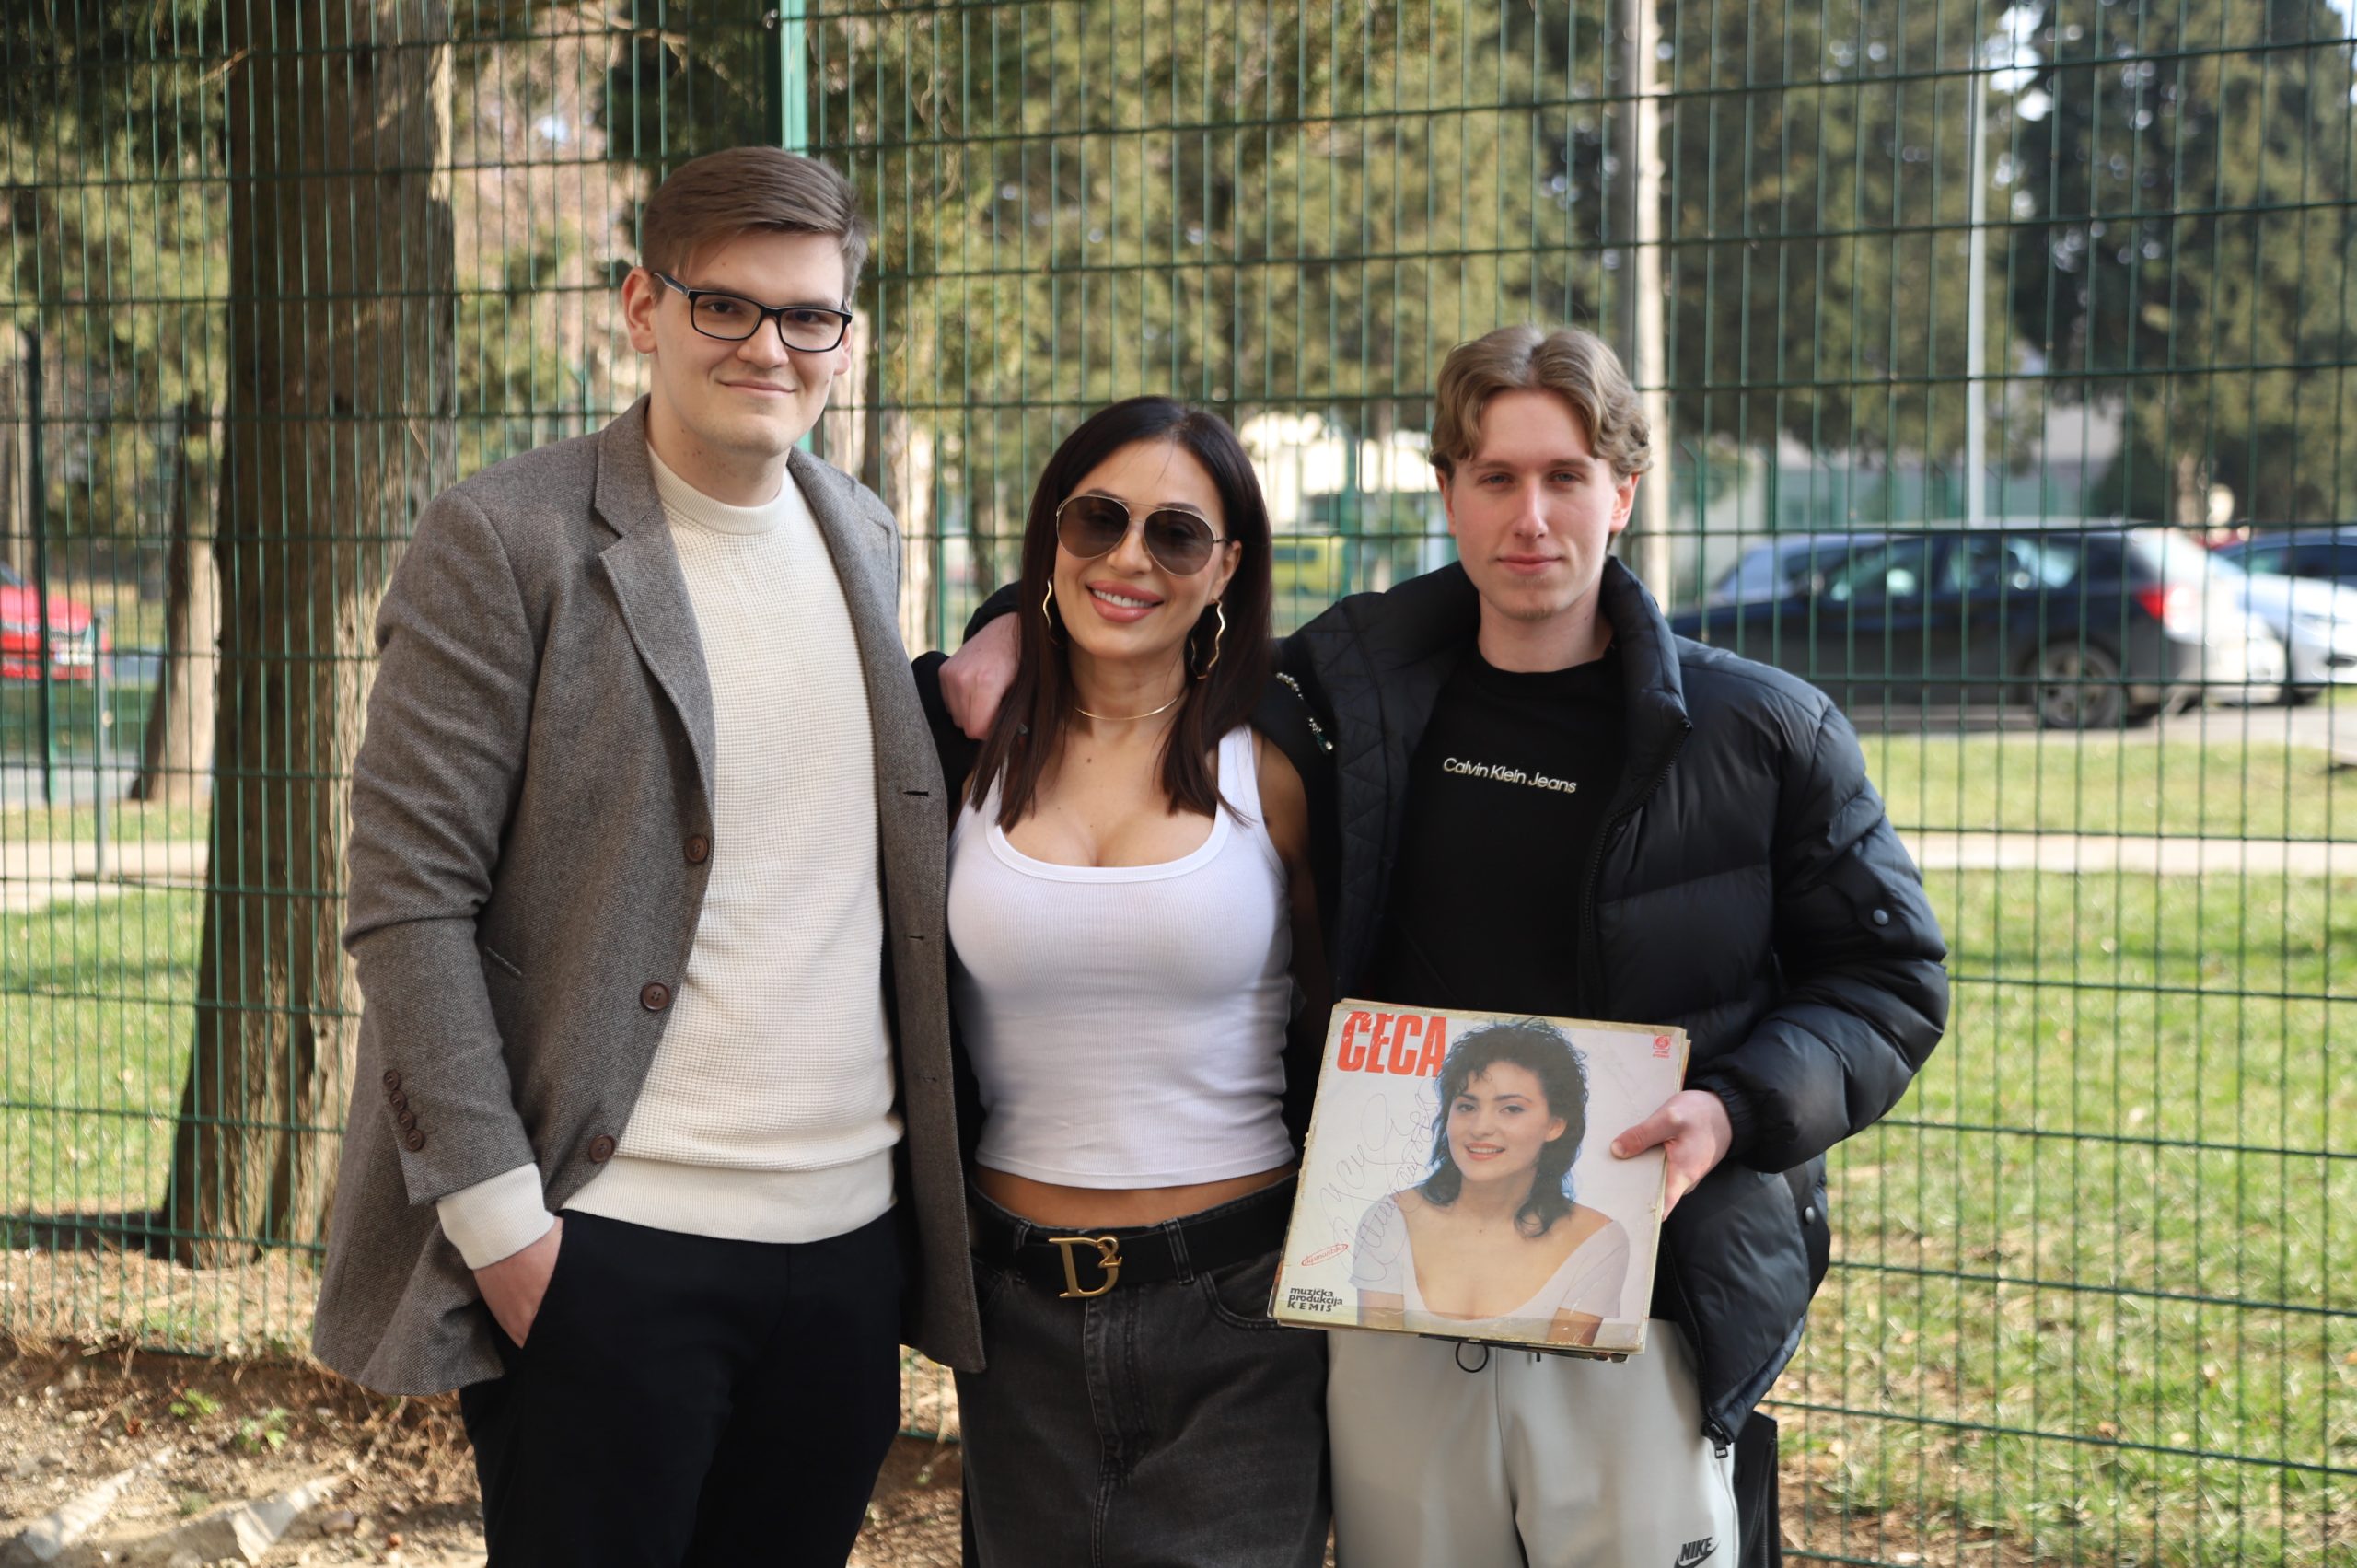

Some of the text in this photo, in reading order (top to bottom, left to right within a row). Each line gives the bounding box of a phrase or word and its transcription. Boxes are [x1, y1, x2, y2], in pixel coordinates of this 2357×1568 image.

[1443, 757, 1577, 793] Calvin Klein Jeans
[1337, 1010, 1446, 1078] CECA
[1288, 1295, 1343, 1307] produkcija
[1679, 1536, 1713, 1562] NIKE
